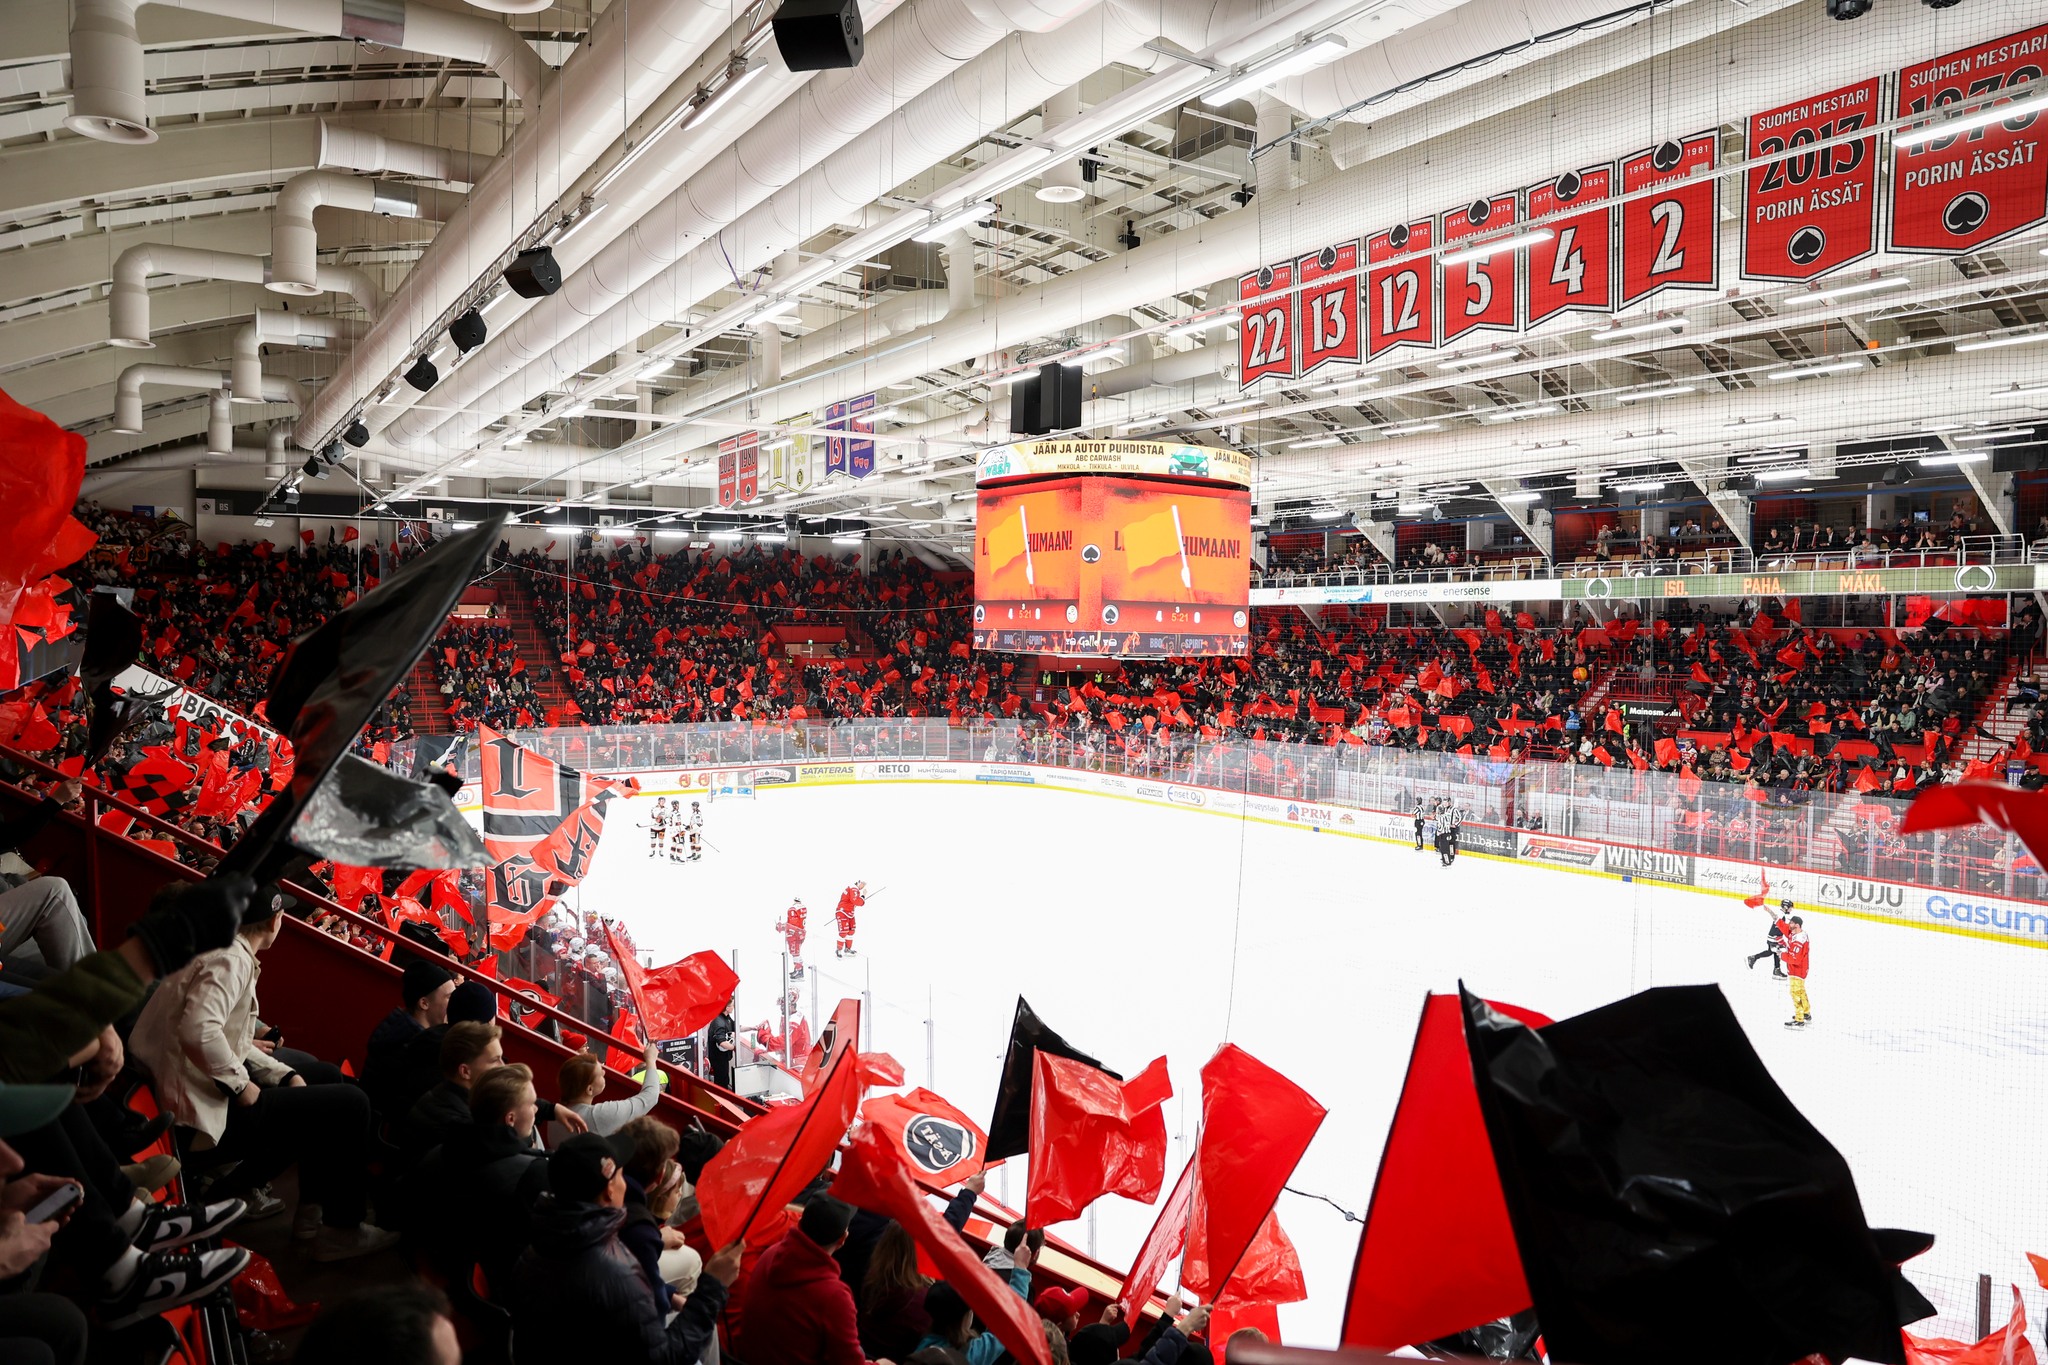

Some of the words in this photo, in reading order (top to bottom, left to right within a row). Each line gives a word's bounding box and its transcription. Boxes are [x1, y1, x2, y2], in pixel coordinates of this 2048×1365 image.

[1909, 58, 1971, 89] SUOMEN
[1975, 33, 2048, 70] MESTARI
[1758, 106, 1809, 131] SUOMEN
[1812, 88, 1870, 116] MESTARI
[1687, 145, 1709, 156] 1981
[1758, 112, 1867, 193] 2013
[1904, 159, 1964, 191] PORIN
[1969, 139, 2038, 176] ÄSSÄT
[1584, 177, 1605, 187] 1994
[1756, 197, 1804, 224] PORIN
[1809, 180, 1864, 213] ÄSSÄT
[1648, 199, 1686, 277] 2
[1550, 225, 1586, 296] 4
[1464, 255, 1493, 316] 5
[1379, 270, 1420, 337] 12
[1310, 287, 1348, 354] 13
[1246, 307, 1287, 370] 22
[1033, 442, 1057, 455] JÄÄN
[1060, 444, 1072, 454] JA
[1074, 443, 1106, 453] AUTOT
[1109, 444, 1165, 456] PUHDISTAA
[1090, 454, 1122, 462] CARWASH
[1214, 450, 1231, 461] JÄÄN
[1384, 588, 1428, 598] enersense
[1443, 586, 1491, 596] enersense
[1663, 580, 1688, 596] ISO.
[1742, 577, 1786, 594] PAHA.
[1839, 571, 1886, 593] MÄKI.
[1018, 610, 1032, 619] 5:21
[1171, 613, 1189, 622] 5:21
[1185, 638, 1203, 649] SPIRIT
[801, 766, 854, 775] SATATERAS
[878, 764, 910, 773] RETCO
[1190, 791, 1201, 803] Oy
[1301, 807, 1332, 821] PRM
[1379, 826, 1414, 841] VALTANEN
[1455, 832, 1517, 850] illibaari.
[1605, 845, 1688, 876] WINSTON
[1700, 868, 1738, 882] Lyttylän
[1781, 879, 1795, 892] Oy
[1846, 881, 1903, 908] JUJU
[1926, 895, 2048, 935] Gasum
